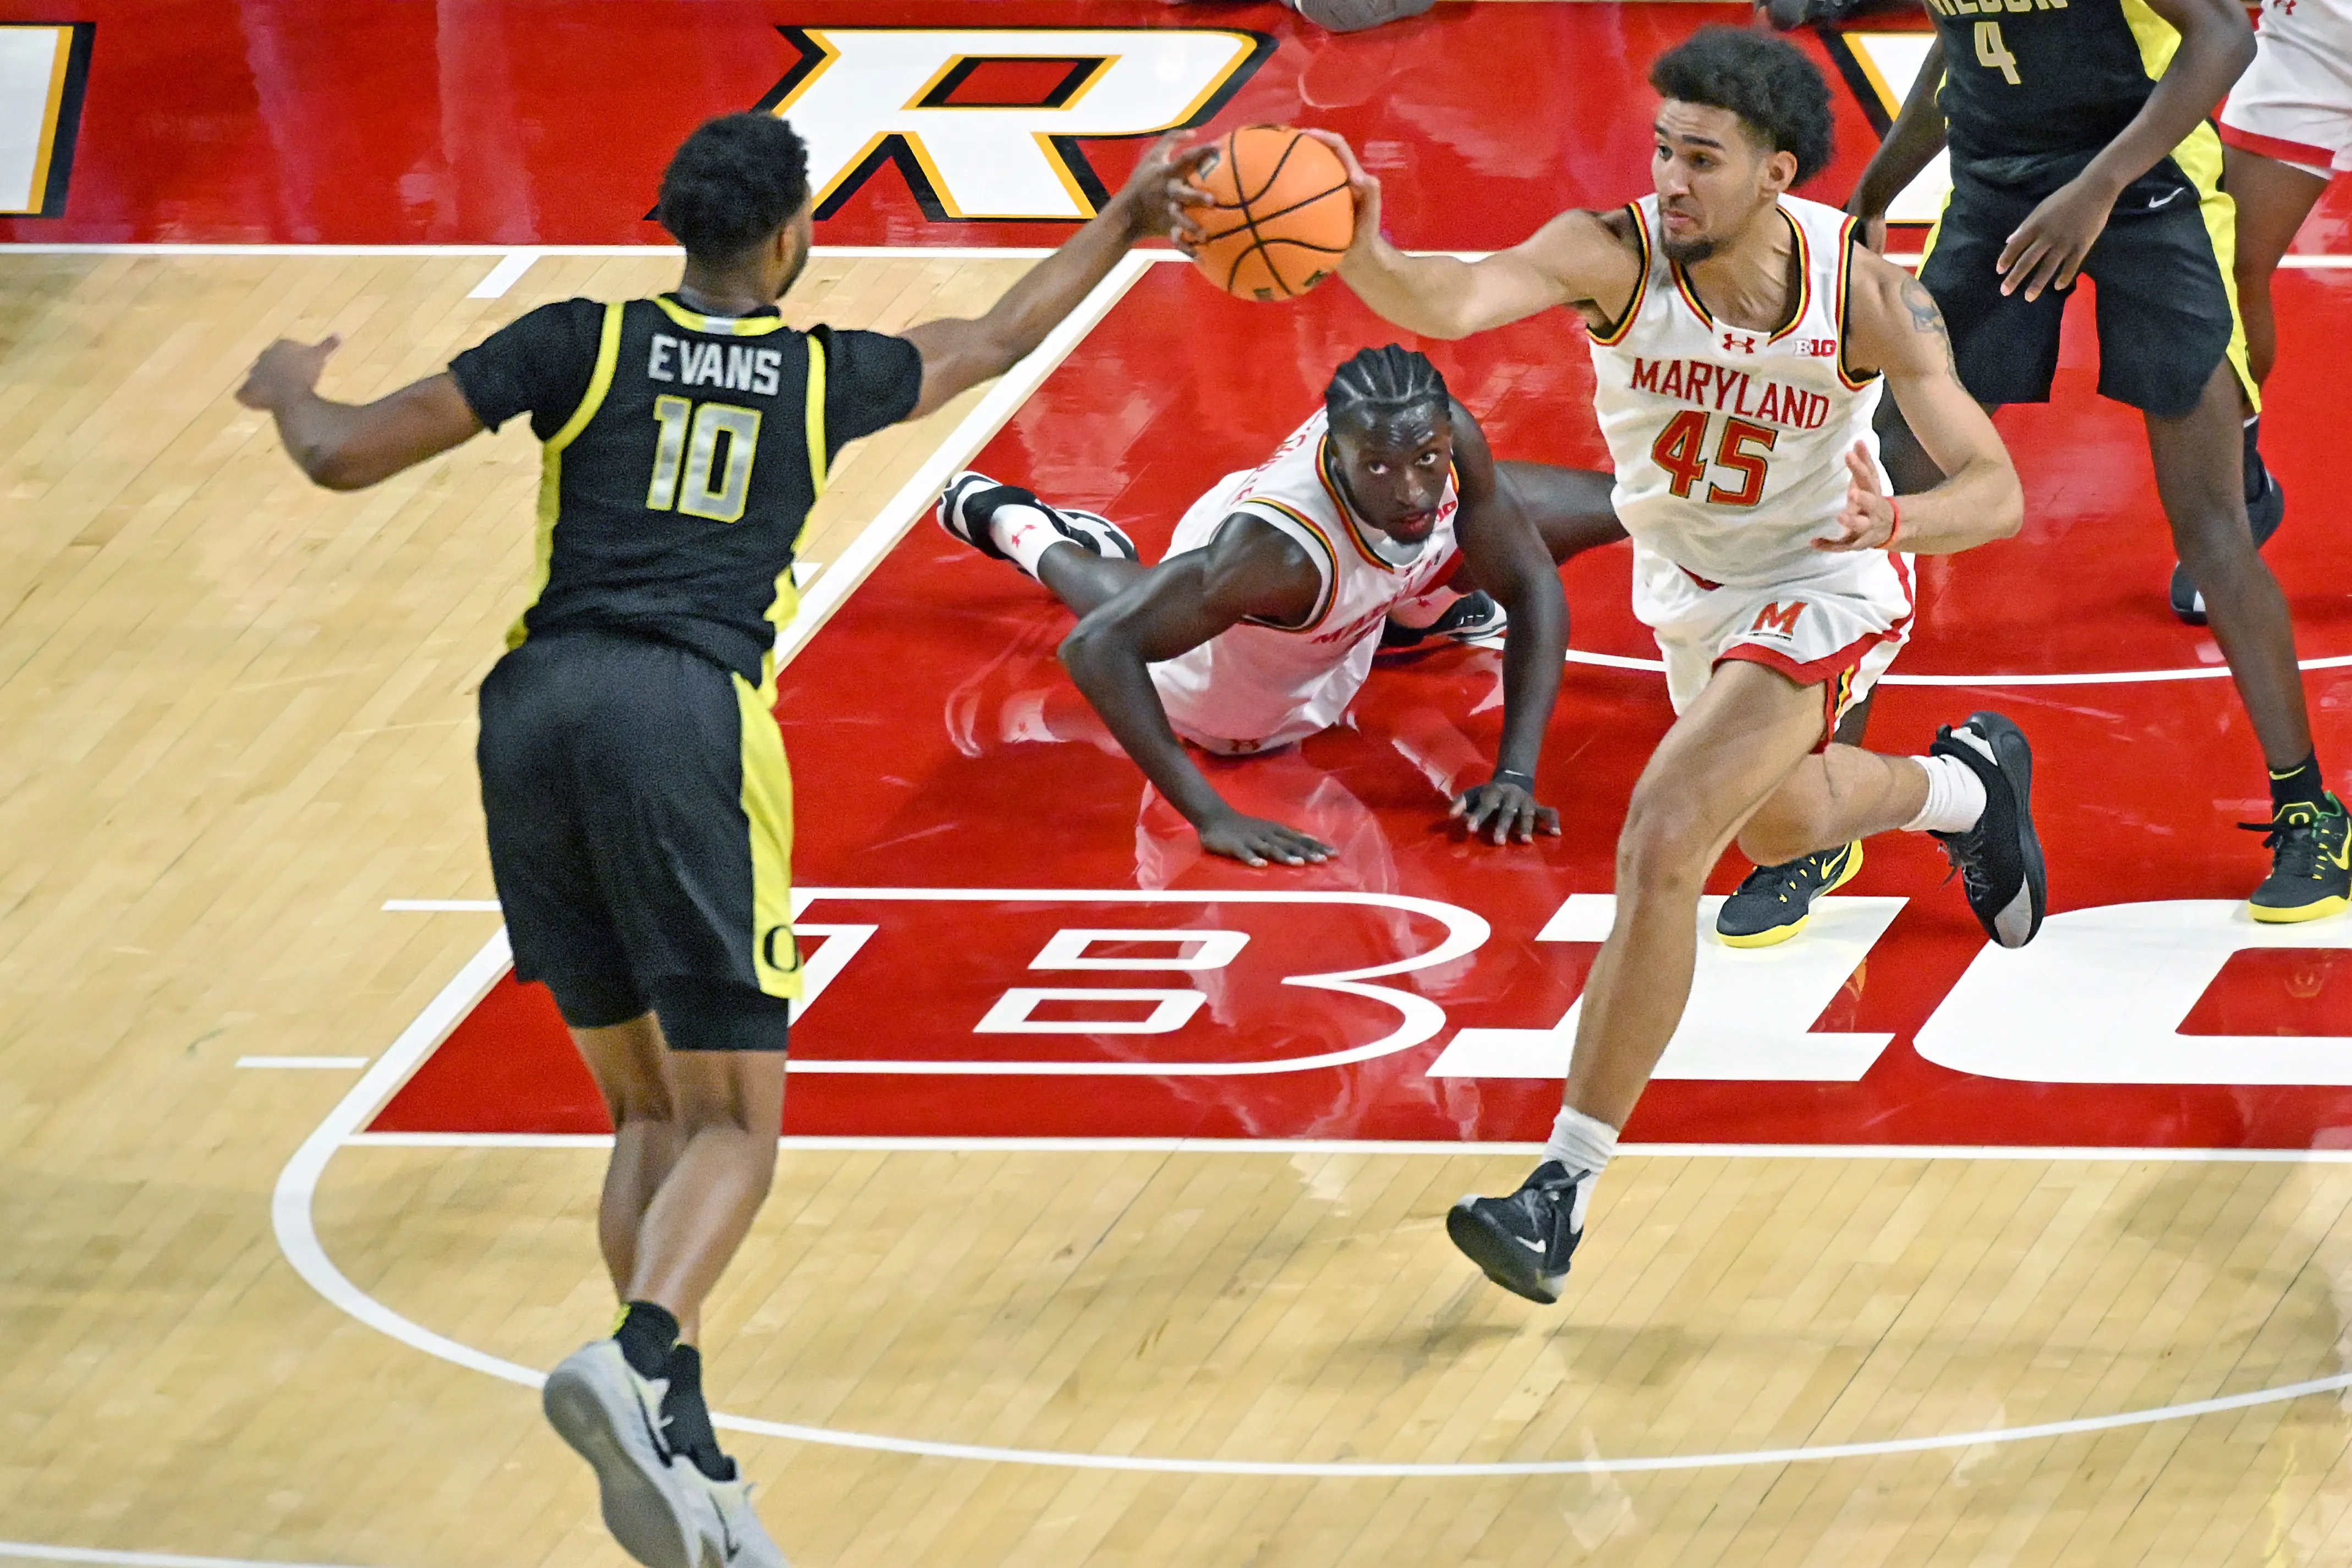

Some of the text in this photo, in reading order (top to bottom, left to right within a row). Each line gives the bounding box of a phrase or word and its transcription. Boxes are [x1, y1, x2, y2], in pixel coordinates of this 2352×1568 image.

[1973, 21, 2021, 85] 4
[648, 333, 782, 396] EVANS
[1630, 357, 1830, 429] MARYLAND
[645, 394, 763, 524] 10
[1651, 409, 1779, 507] 45
[1750, 601, 1808, 637] M
[763, 924, 799, 973] O
